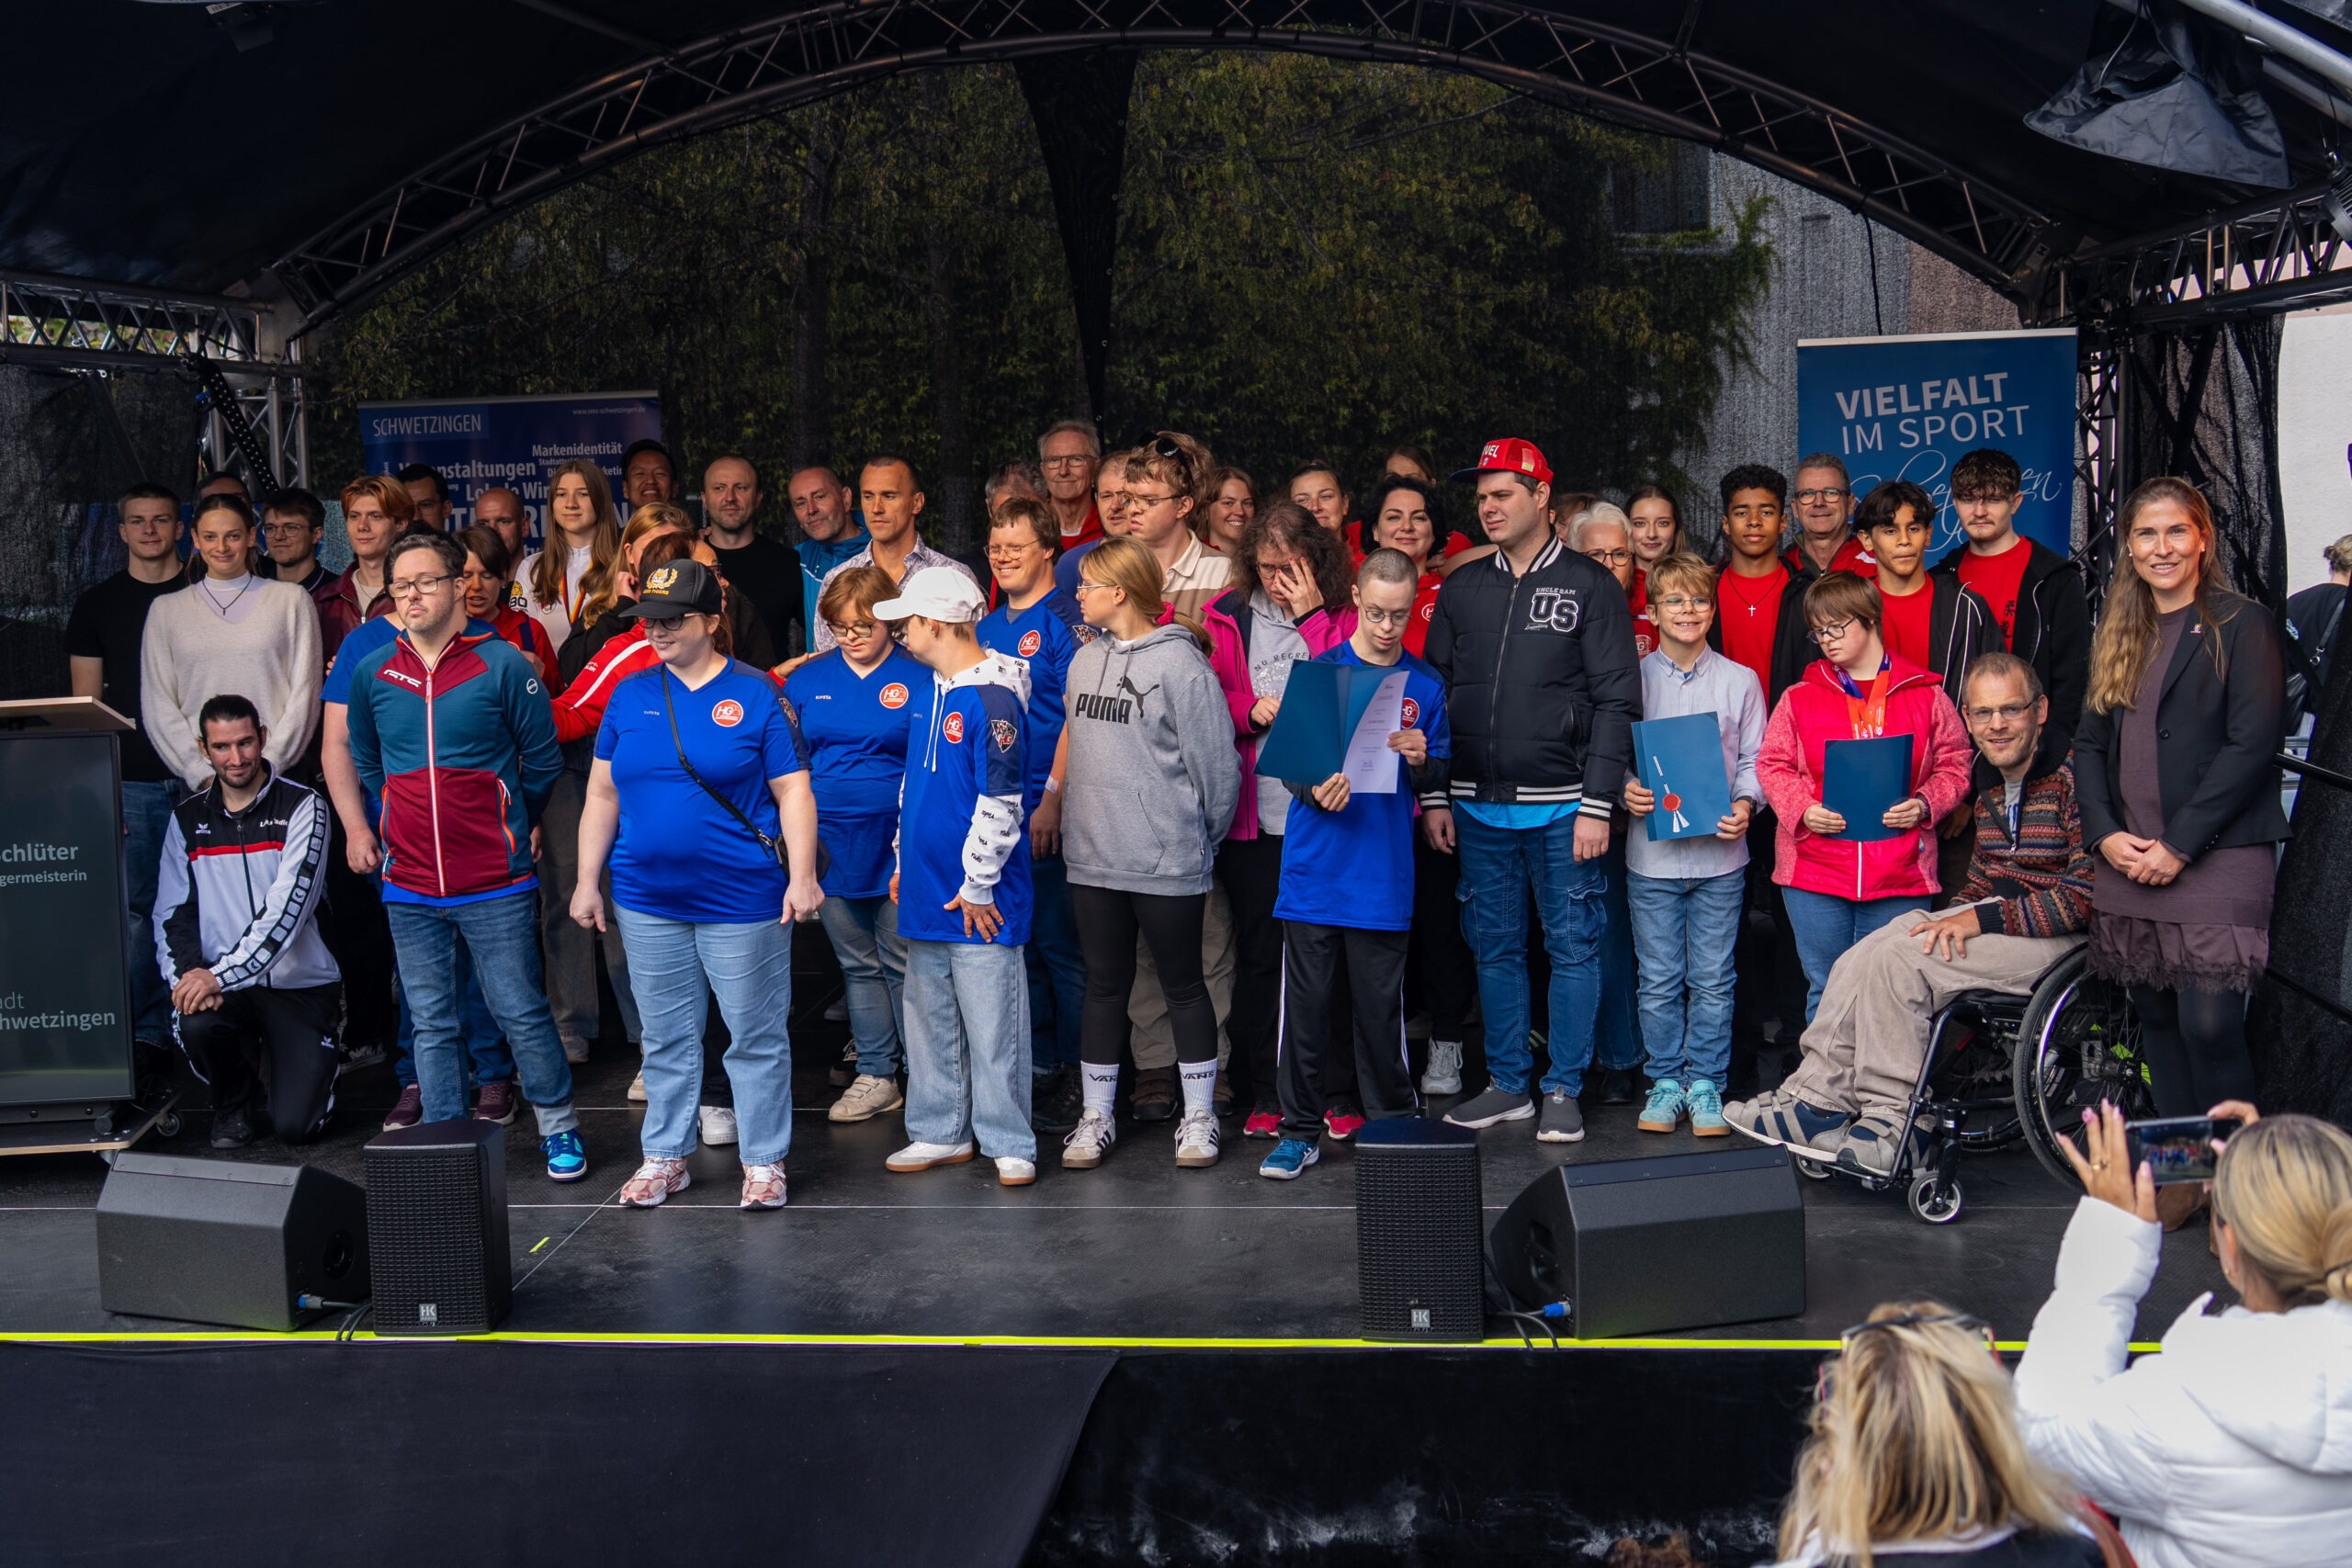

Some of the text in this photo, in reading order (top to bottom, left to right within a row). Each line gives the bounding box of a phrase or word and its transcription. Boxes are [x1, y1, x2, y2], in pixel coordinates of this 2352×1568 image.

[1835, 372, 2008, 420] VIELFALT
[373, 413, 481, 437] SCHWETZINGEN
[1842, 405, 2030, 455] IM SPORT
[532, 441, 623, 457] Markenidentität
[1530, 592, 1578, 632] US
[1273, 651, 1308, 661] REGRE
[1075, 693, 1133, 725] PUMA
[0, 843, 78, 863] chlüter
[1182, 1069, 1216, 1080] VANS
[421, 1305, 435, 1316] HK
[1413, 1311, 1428, 1323] HK
